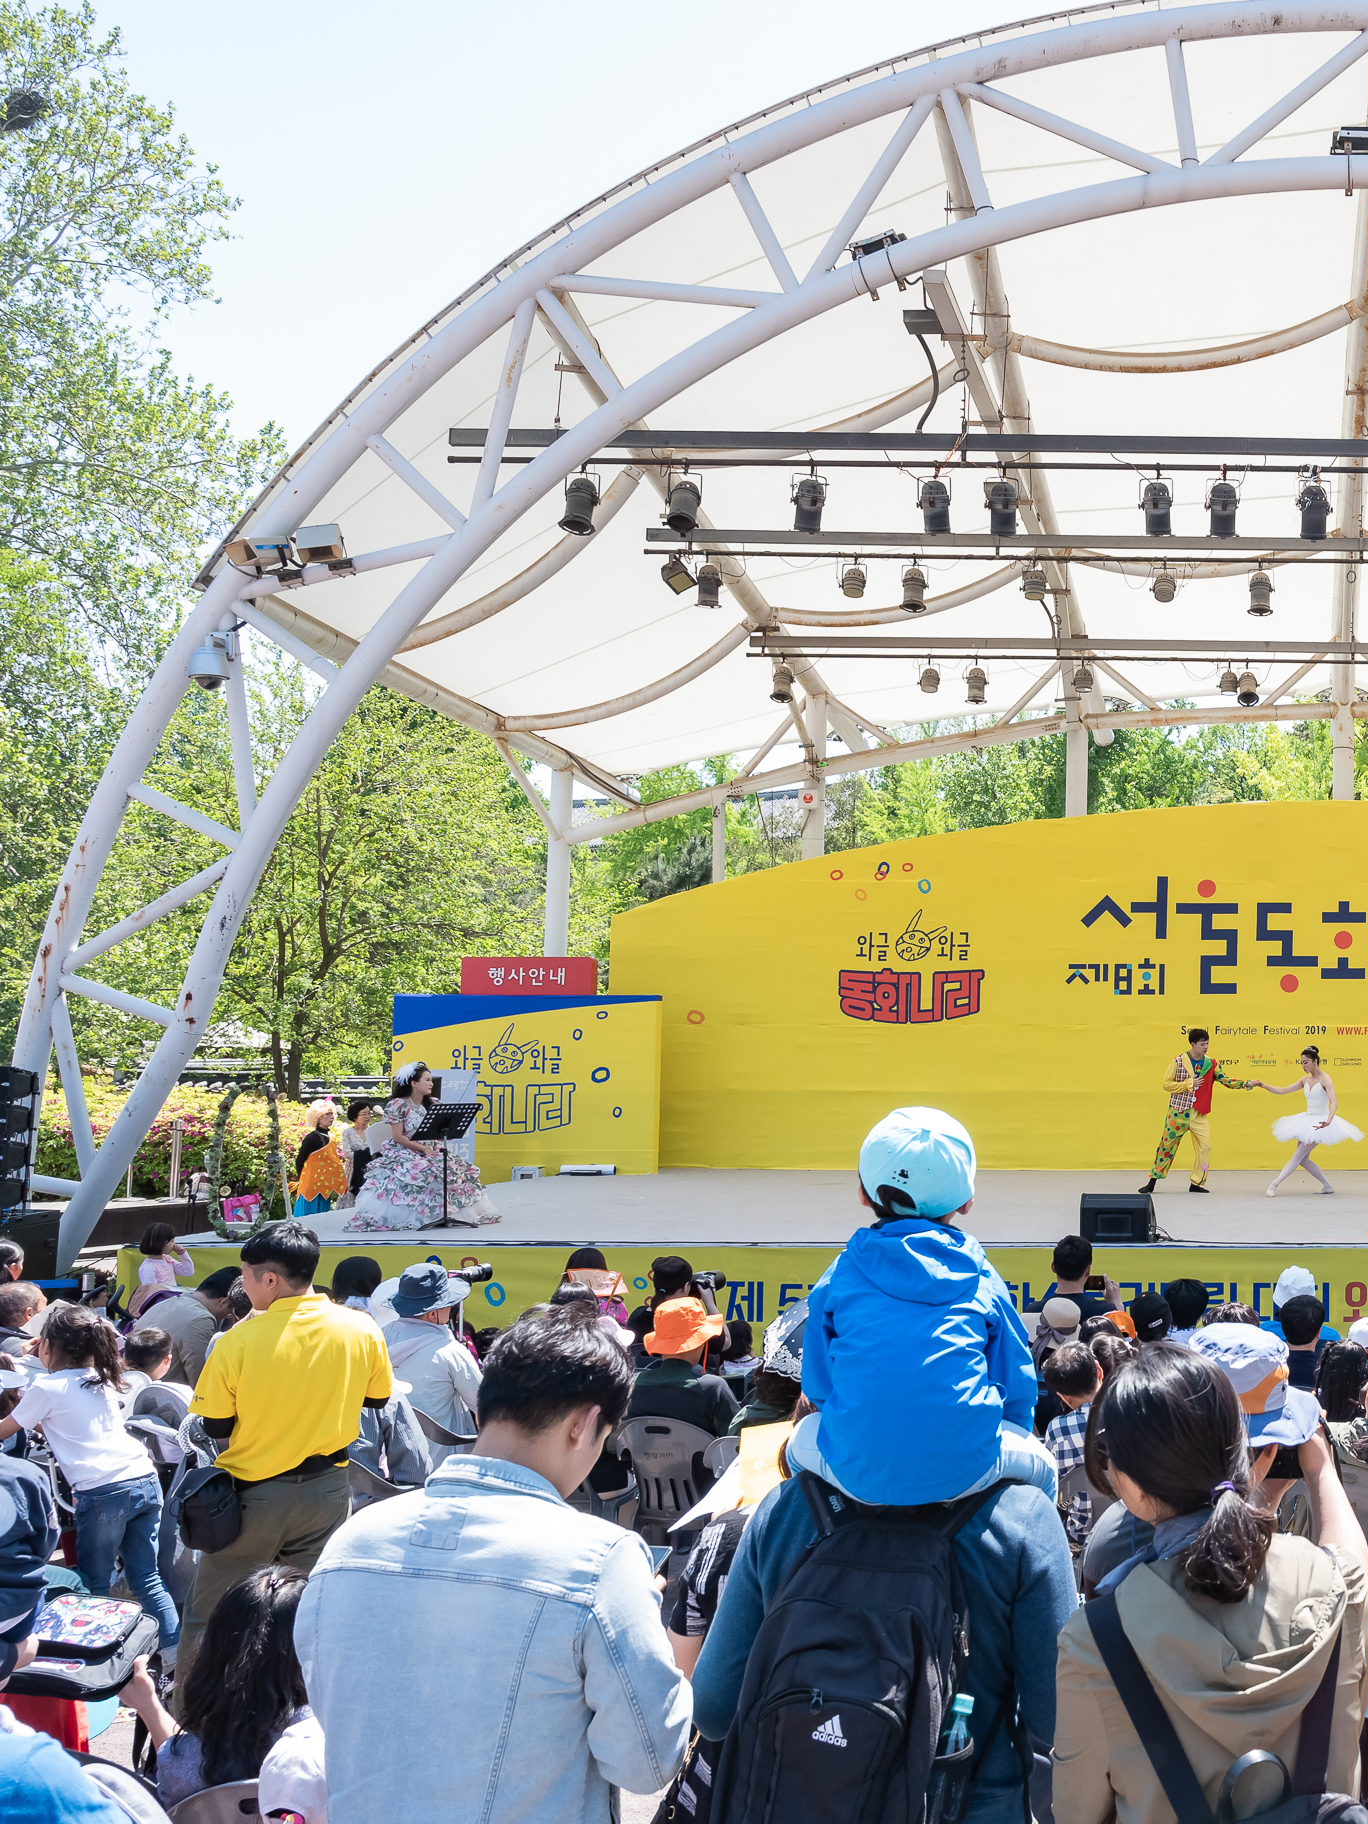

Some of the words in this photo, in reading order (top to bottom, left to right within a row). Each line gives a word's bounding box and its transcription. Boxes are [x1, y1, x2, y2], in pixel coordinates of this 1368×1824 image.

[856, 932, 889, 961] 와글
[937, 932, 970, 961] 와글
[838, 968, 985, 1024] 동화나라
[1215, 1026, 1257, 1036] Fairytale
[1264, 1026, 1300, 1035] Festival
[1305, 1026, 1327, 1035] 2019
[451, 1045, 484, 1074] 와글
[529, 1045, 562, 1074] 와글
[725, 1281, 764, 1322] 제
[811, 1730, 848, 1748] adidas
